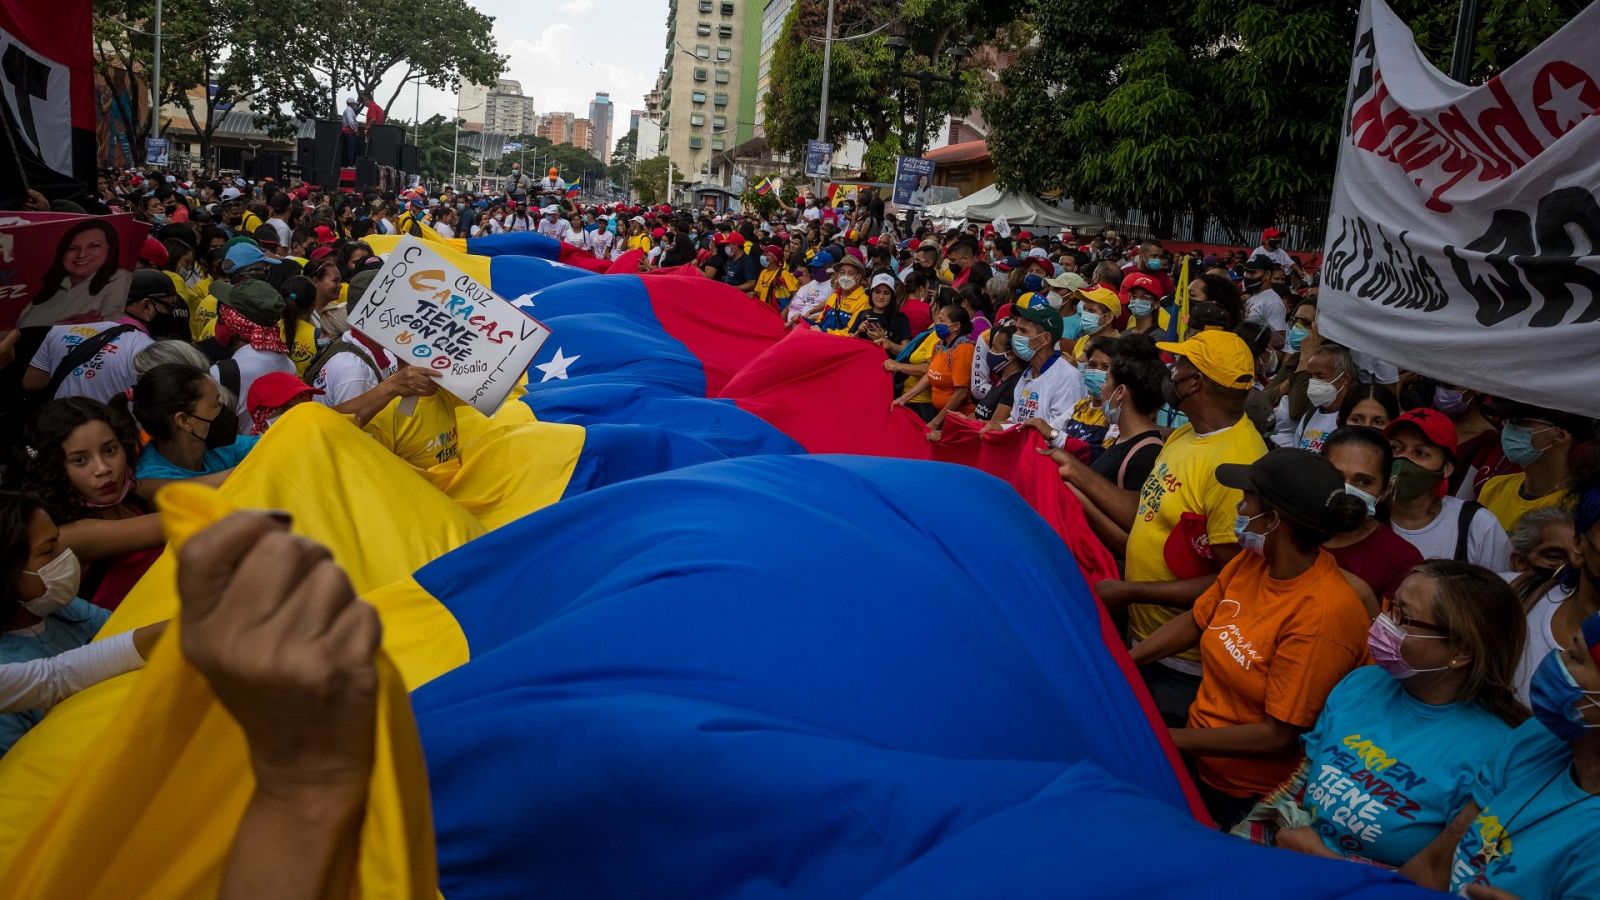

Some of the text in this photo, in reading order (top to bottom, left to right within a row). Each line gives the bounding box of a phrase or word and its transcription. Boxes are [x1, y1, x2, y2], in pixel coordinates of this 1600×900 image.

[354, 246, 422, 330] COMUNA
[408, 269, 513, 345] CARACAS
[454, 275, 494, 308] CRUZ
[400, 314, 437, 340] CON
[415, 299, 479, 347] TIENE
[469, 318, 538, 404] VILLEGA
[1318, 764, 1389, 821] TIENE
[1322, 744, 1422, 821] MELENDEZ
[1343, 734, 1427, 792] CARMEN
[1307, 782, 1384, 843] CON QUÉ
